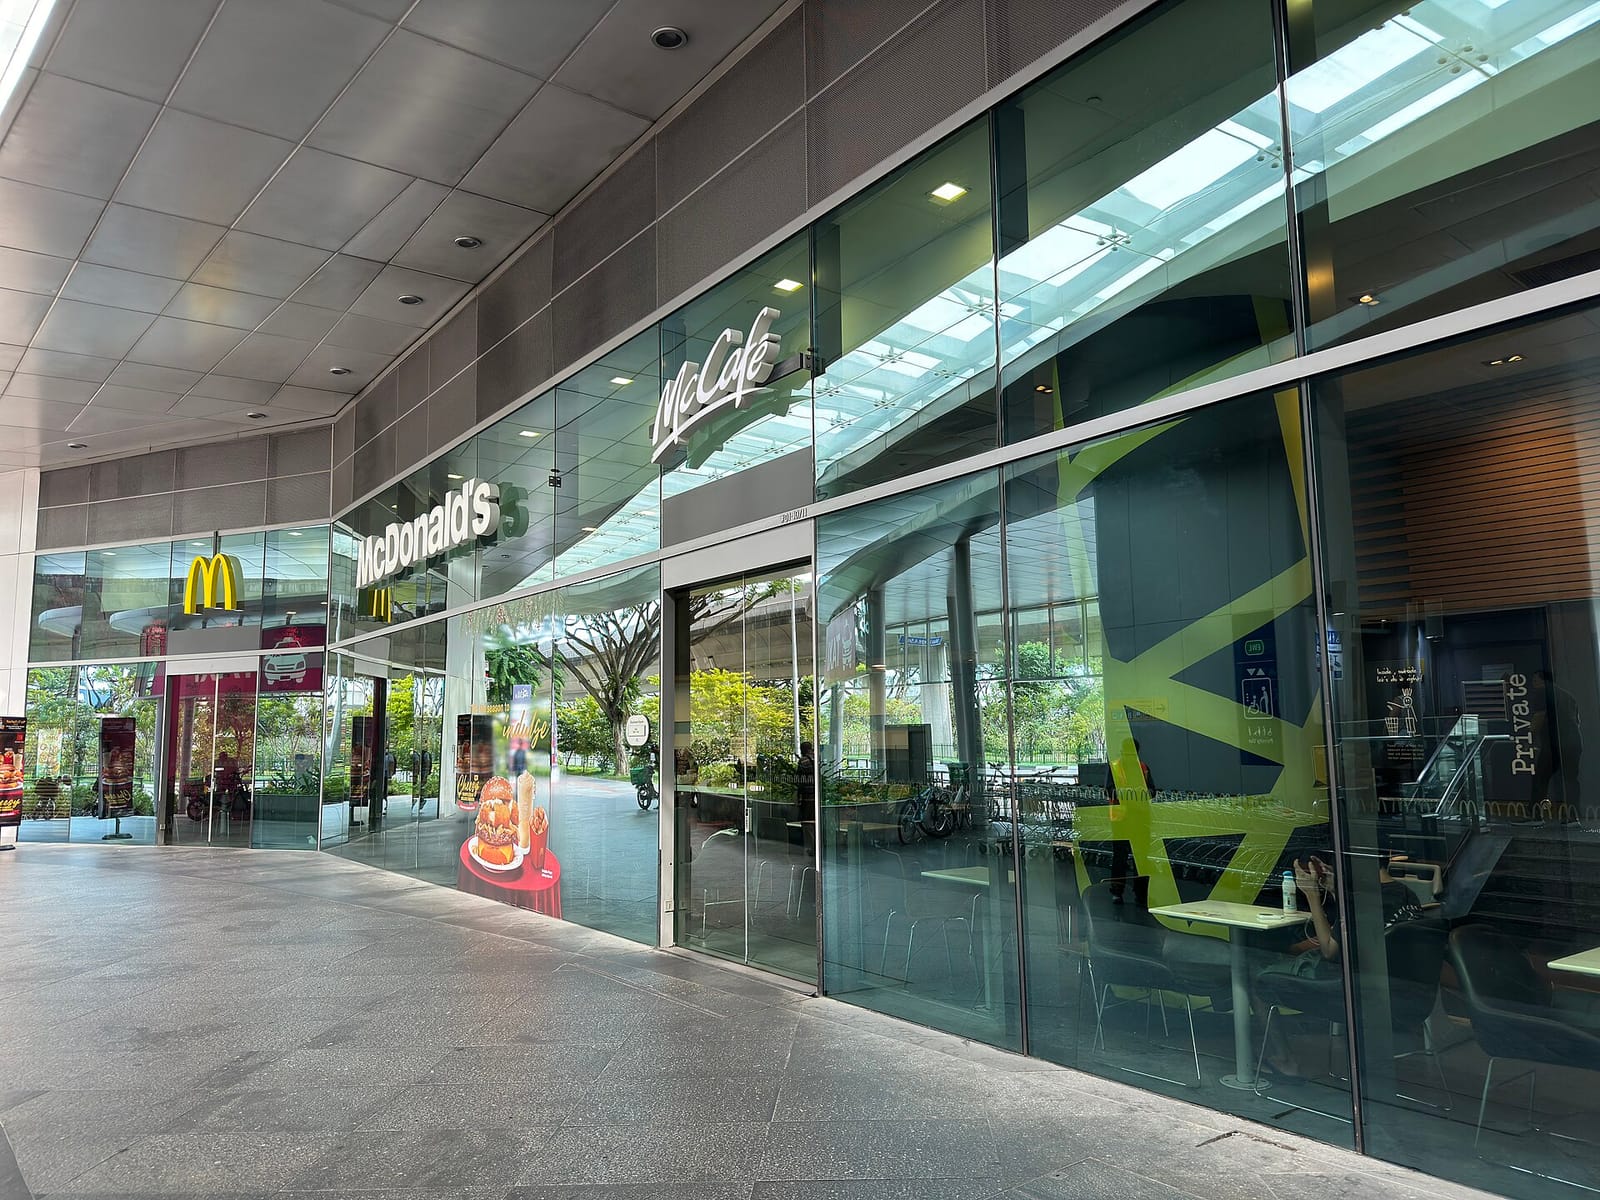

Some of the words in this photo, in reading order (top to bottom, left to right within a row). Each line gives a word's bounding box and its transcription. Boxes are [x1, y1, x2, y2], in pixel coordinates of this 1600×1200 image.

[652, 306, 782, 463] McCafé
[355, 477, 501, 589] McDonald's
[502, 708, 550, 750] indulge
[1509, 673, 1536, 776] Private
